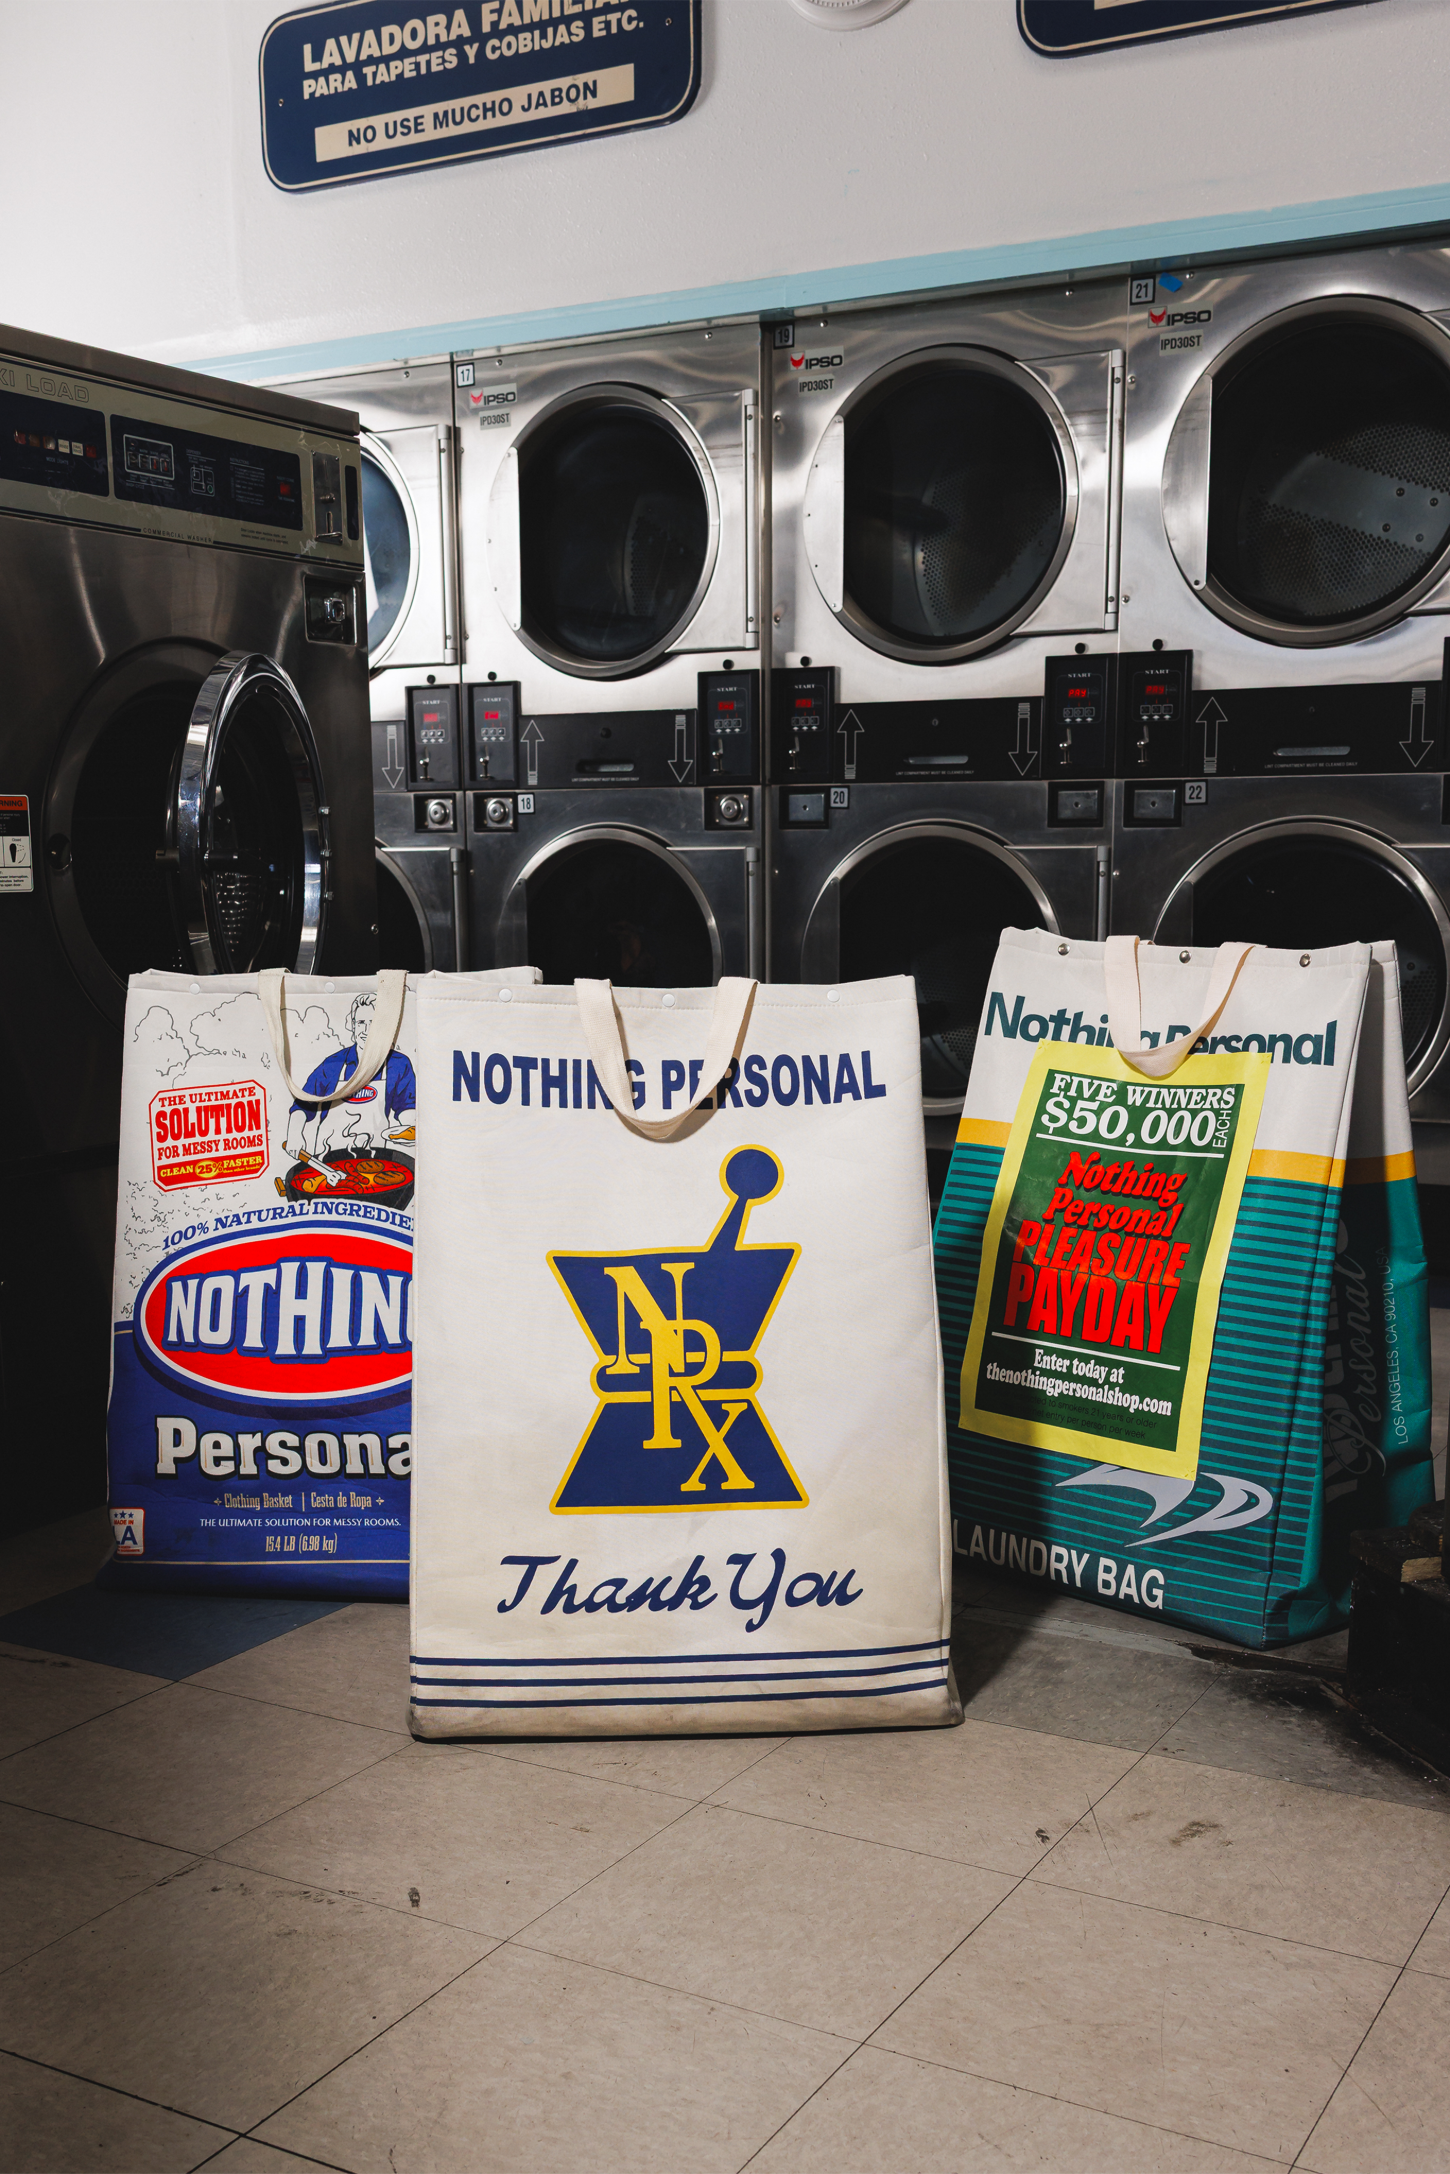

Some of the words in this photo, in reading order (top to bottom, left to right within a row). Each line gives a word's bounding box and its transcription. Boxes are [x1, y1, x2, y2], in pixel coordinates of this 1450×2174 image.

[303, 9, 472, 73] LAVADORA
[303, 70, 358, 100] PARA
[362, 48, 458, 87] TAPETES
[464, 44, 480, 65] Y
[485, 20, 586, 61] COBIJAS
[592, 9, 644, 38] ETC.
[347, 125, 377, 148] NO
[384, 113, 426, 140] USE
[433, 96, 513, 131] MUCHO
[520, 79, 598, 113] JABON
[1135, 283, 1149, 299] 21
[1167, 310, 1211, 326] IPSO
[778, 328, 790, 343] 19
[1160, 335, 1202, 350] IPD30ST
[460, 368, 470, 382] 17
[805, 355, 843, 370] IPSO
[26, 373, 89, 403] LOAD
[483, 391, 516, 406] IPSO
[799, 378, 834, 392] IPD30ST
[480, 413, 510, 426] IPD30ST
[143, 527, 185, 540] COMMERCIAL
[187, 534, 213, 543] WASHER
[521, 796, 532, 810] 18
[832, 790, 845, 805] 20
[1188, 784, 1203, 799] 22
[158, 1094, 186, 1108] THE
[188, 1085, 257, 1104] ULTIMATE
[1049, 1072, 1118, 1103] FIVE
[1125, 1084, 1236, 1110] WINNERS
[154, 1098, 262, 1144] SOLUTION
[1040, 1090, 1217, 1147] $50,000
[1212, 1109, 1232, 1148] EACH
[157, 1145, 181, 1161] FOR
[182, 1138, 221, 1157] MESSY
[222, 1133, 263, 1151] ROOMS
[159, 1164, 194, 1178] CLEAN
[196, 1160, 223, 1176] 25%
[222, 1155, 263, 1169] FASTER
[1057, 1151, 1188, 1208] Nothing
[161, 1220, 210, 1251] 100%
[212, 1201, 310, 1232] NATURAL
[311, 1200, 414, 1232] INGREDIE
[1041, 1187, 1185, 1238] Personal
[1012, 1219, 1192, 1288] PLEASURE
[1374, 1246, 1392, 1276] USA
[165, 1259, 413, 1357] NOTHIN
[1003, 1261, 1180, 1355] PAYDAY
[1382, 1278, 1397, 1321] 90210,
[1384, 1324, 1398, 1344] CA
[1034, 1348, 1071, 1373] Enter
[1071, 1358, 1109, 1384] today
[1110, 1366, 1125, 1384] at
[1387, 1346, 1405, 1413] ANGELES,
[985, 1362, 1173, 1416] thenothingpersonalshop.com
[1045, 1410, 1066, 1424] entry
[1066, 1416, 1080, 1426] per
[1080, 1418, 1107, 1432] person
[1108, 1425, 1123, 1435] per
[1124, 1428, 1146, 1440] week
[1058, 1401, 1090, 1415] smokers
[1090, 1407, 1101, 1417] 21
[1101, 1410, 1124, 1423] years
[1125, 1416, 1135, 1424] or
[1135, 1416, 1157, 1429] older
[1392, 1415, 1410, 1445] LOS
[155, 1416, 411, 1477] Persona
[224, 1493, 261, 1511] Clothing
[263, 1493, 293, 1508] Basket
[311, 1493, 335, 1508] Cesta
[336, 1493, 347, 1507] de
[350, 1492, 372, 1509] Ropa
[200, 1518, 216, 1527] THE
[218, 1518, 263, 1527] ULTIMATE
[265, 1518, 311, 1527] SOLUTION
[313, 1518, 331, 1527] FOR
[333, 1518, 362, 1527] MESSY
[364, 1518, 402, 1527] ROOMS.
[265, 1535, 281, 1553] 15.4
[283, 1535, 296, 1552] LB
[298, 1532, 320, 1554] (6.98
[322, 1532, 338, 1554] kg)
[953, 1518, 1091, 1589] LAUNDRY
[1097, 1556, 1165, 1610] BAG
[497, 1554, 718, 1615] Thank
[726, 1547, 864, 1633] You
